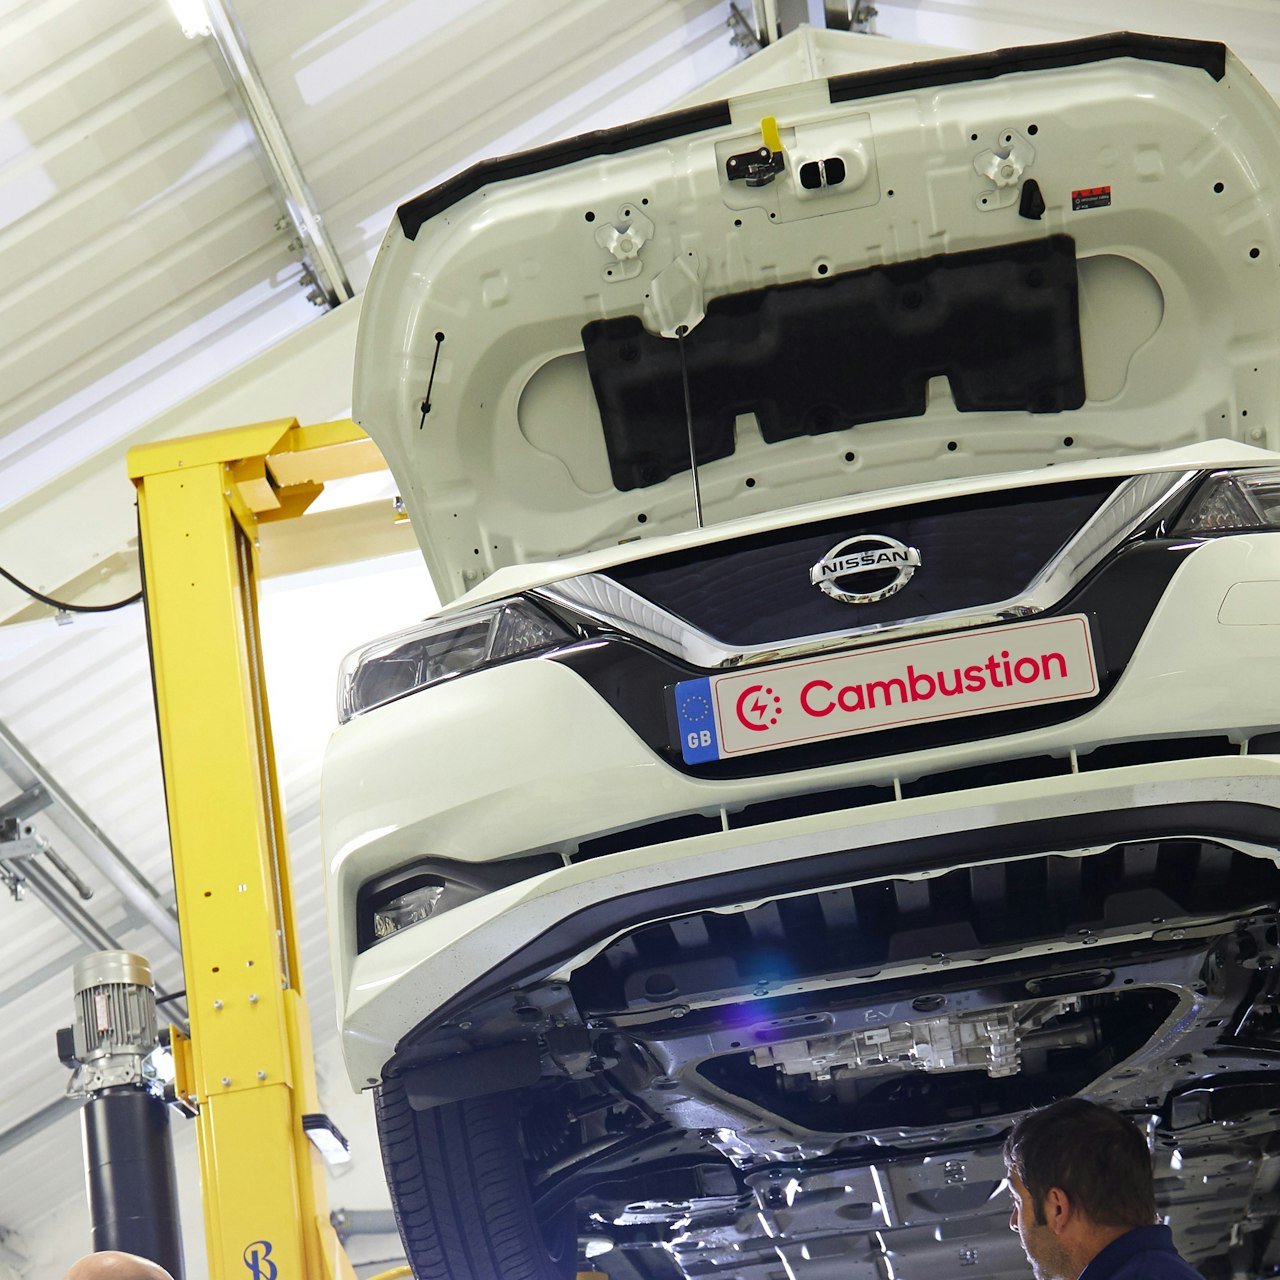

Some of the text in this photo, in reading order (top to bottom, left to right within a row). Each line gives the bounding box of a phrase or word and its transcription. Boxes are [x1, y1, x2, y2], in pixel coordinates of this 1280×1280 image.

[821, 550, 909, 576] NISSAN
[799, 650, 1068, 718] Cambustion
[687, 730, 712, 749] GB
[863, 1004, 897, 1023] EV
